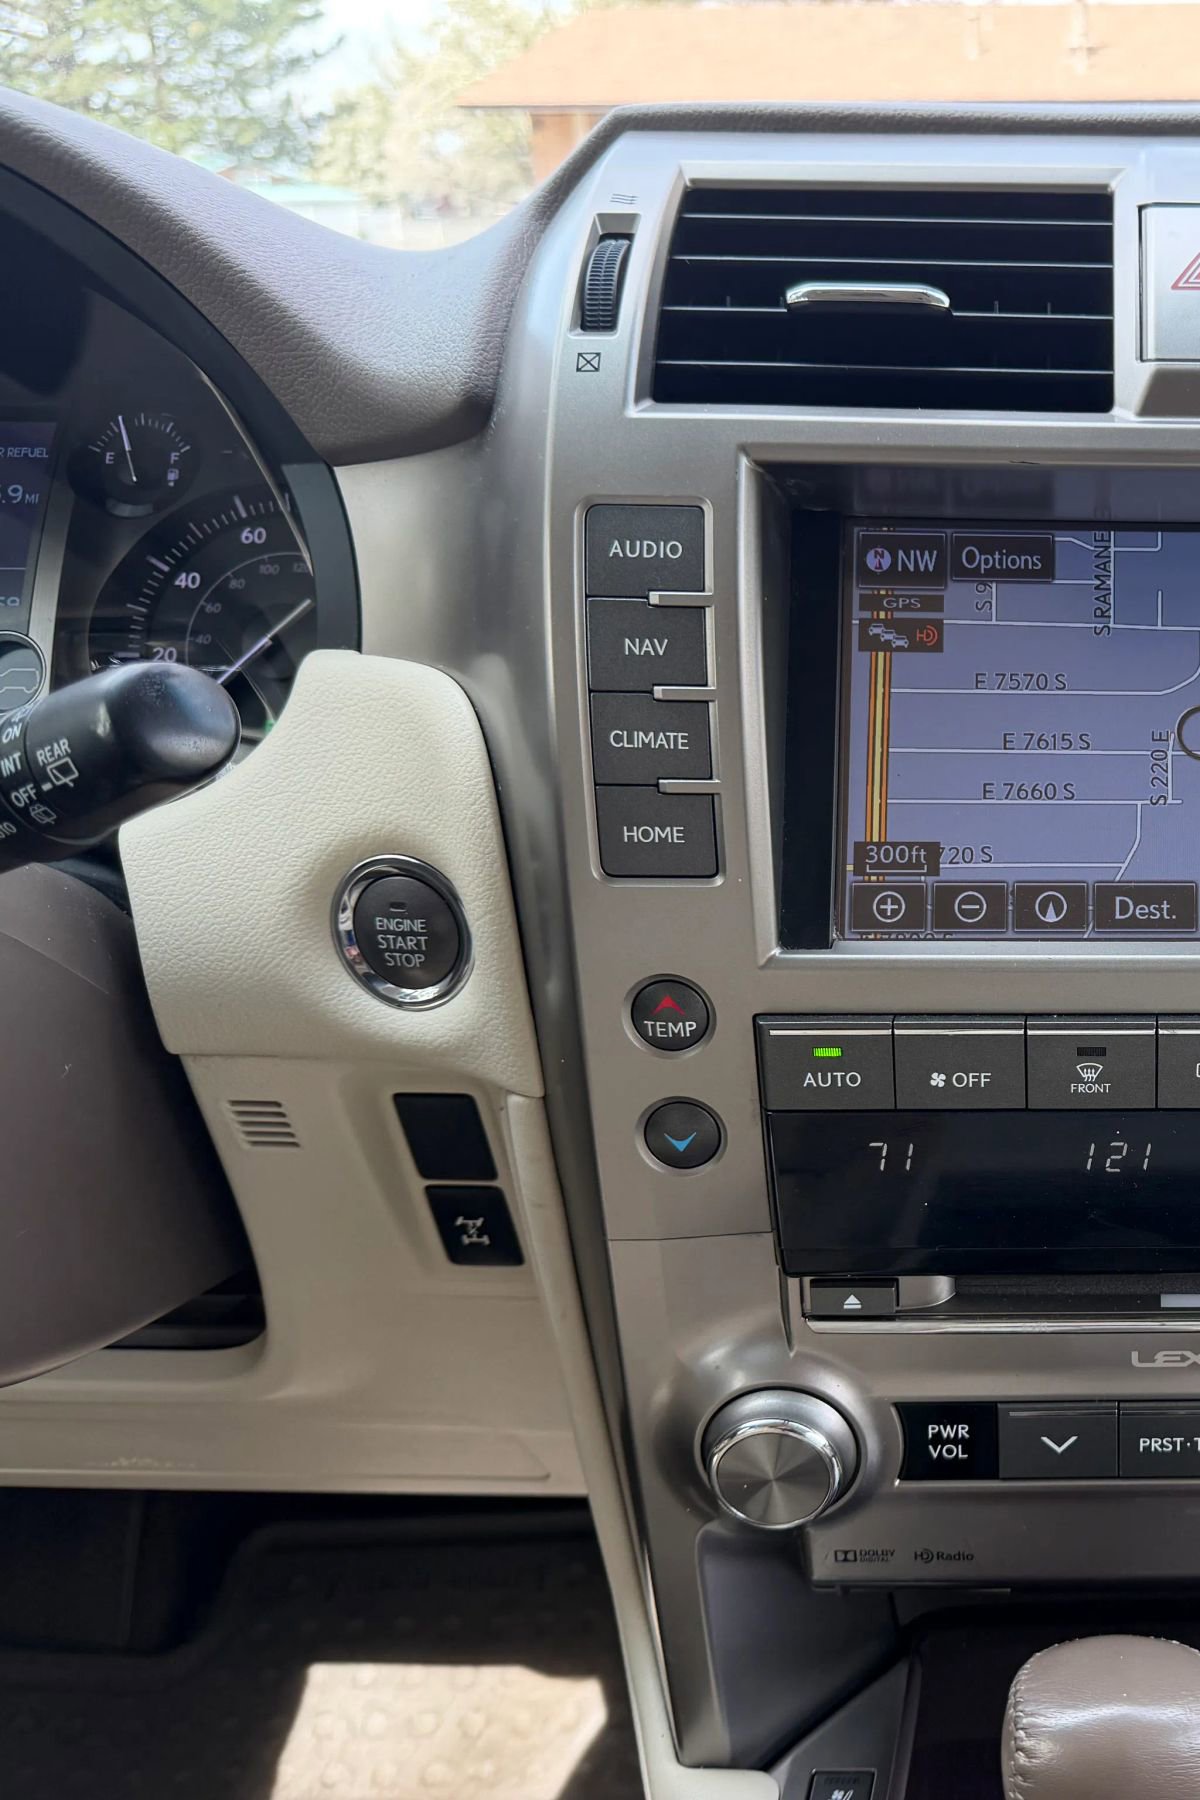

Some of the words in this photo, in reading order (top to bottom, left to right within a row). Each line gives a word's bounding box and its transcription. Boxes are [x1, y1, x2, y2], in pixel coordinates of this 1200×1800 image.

[8, 447, 48, 458] REFUEL
[105, 452, 114, 464] E
[170, 452, 179, 464] F
[240, 528, 266, 543] 60
[609, 541, 683, 558] AUDIO
[897, 549, 937, 572] NW
[961, 546, 1043, 574] Options
[174, 572, 200, 588] 40
[883, 597, 921, 609] GPS
[1094, 624, 1111, 636] S
[153, 647, 177, 663] 20
[624, 638, 668, 655] NAV
[975, 673, 986, 690] E
[996, 673, 1048, 690] 7570
[1055, 673, 1067, 690] S
[2, 723, 22, 743] ON
[610, 731, 689, 749] CLIMATE
[1003, 733, 1015, 750] E
[1024, 733, 1073, 750] 7615
[1079, 733, 1090, 750] S
[1151, 730, 1169, 742] E
[36, 738, 72, 766] REAR
[0, 752, 22, 777] INT
[1150, 749, 1168, 788] 220
[11, 783, 37, 808] OFF
[982, 783, 995, 800] E
[1003, 783, 1056, 800] 7660
[1064, 783, 1075, 800] S
[1150, 794, 1168, 806] S
[623, 826, 685, 843] HOME
[865, 845, 927, 864] 300ft
[980, 846, 993, 863] S
[1114, 896, 1177, 920] Dest.
[375, 917, 427, 933] ENGINE
[378, 935, 428, 951] START
[384, 952, 426, 968] STOP
[644, 1020, 697, 1038] TEMP
[803, 1072, 861, 1088] AUTO
[952, 1073, 992, 1088] OFF
[1070, 1083, 1111, 1094] FRONT
[868, 1142, 914, 1171] 71
[1085, 1141, 1151, 1173] 121
[928, 1424, 970, 1440] PWR
[928, 1444, 969, 1460] VOL
[936, 1551, 975, 1562] Radio
